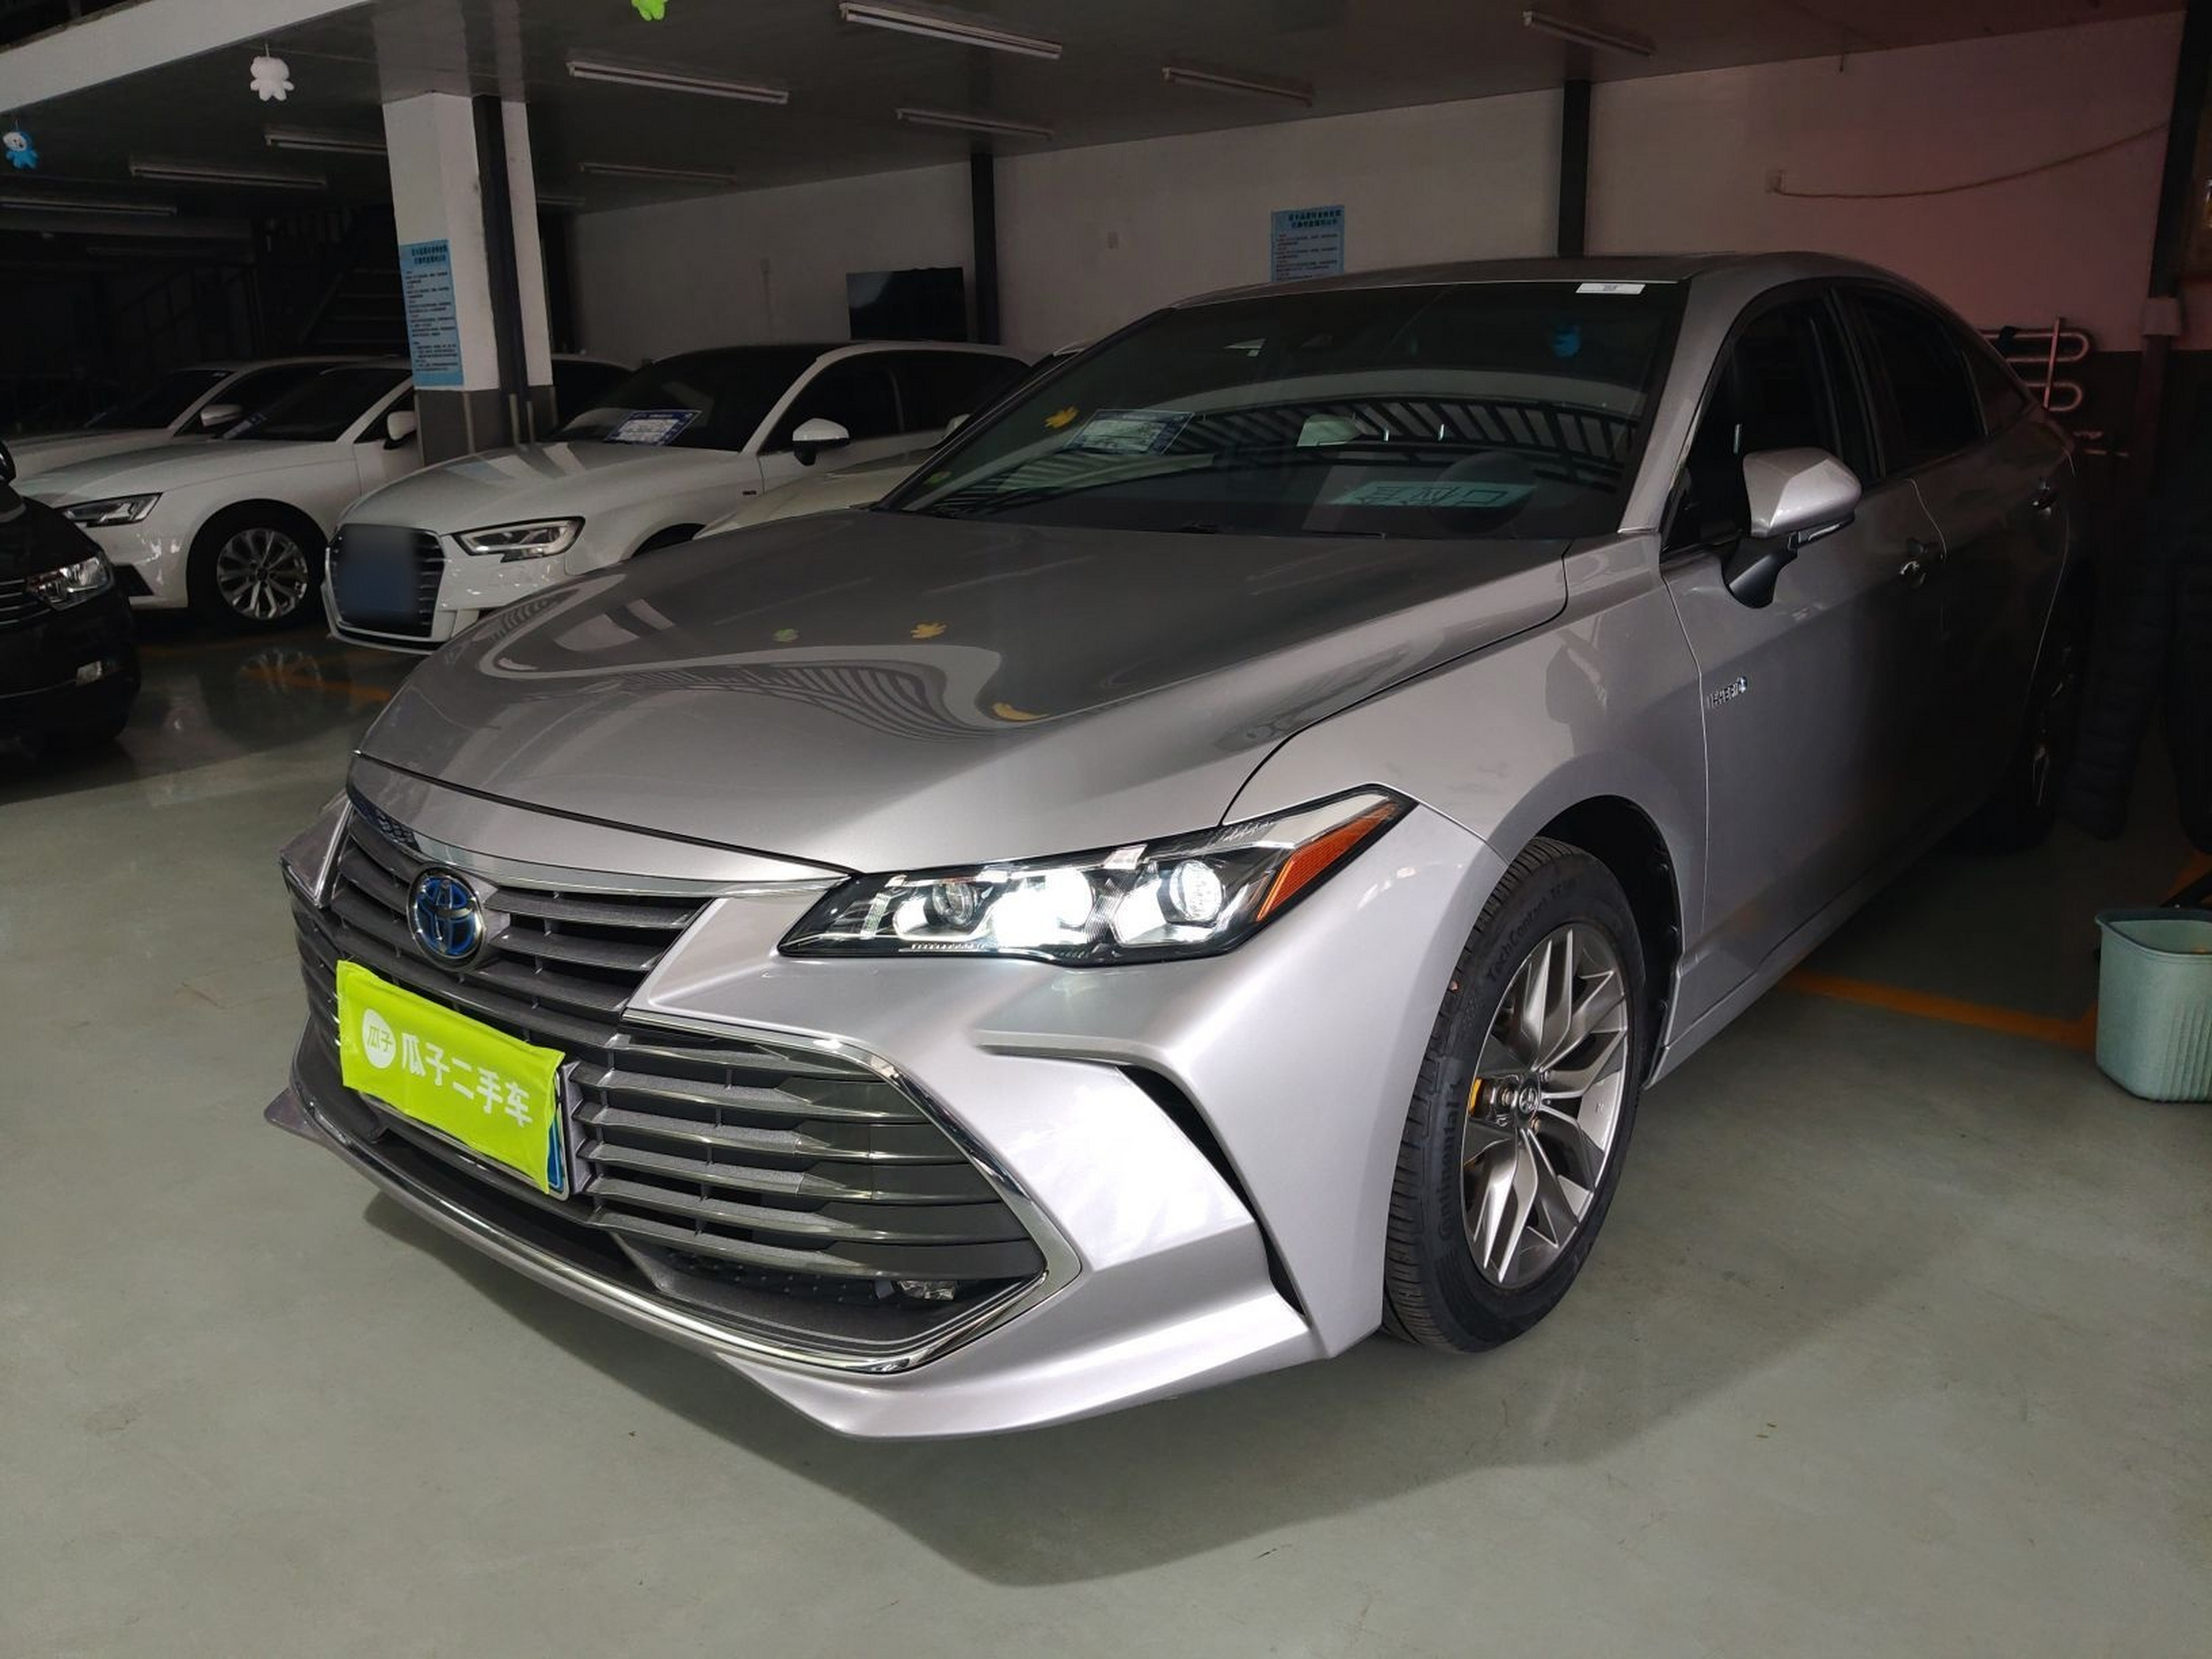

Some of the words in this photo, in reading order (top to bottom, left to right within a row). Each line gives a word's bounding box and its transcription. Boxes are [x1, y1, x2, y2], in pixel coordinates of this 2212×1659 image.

[366, 1026, 393, 1053] 瓜子
[400, 1031, 533, 1128] 瓜子二手车
